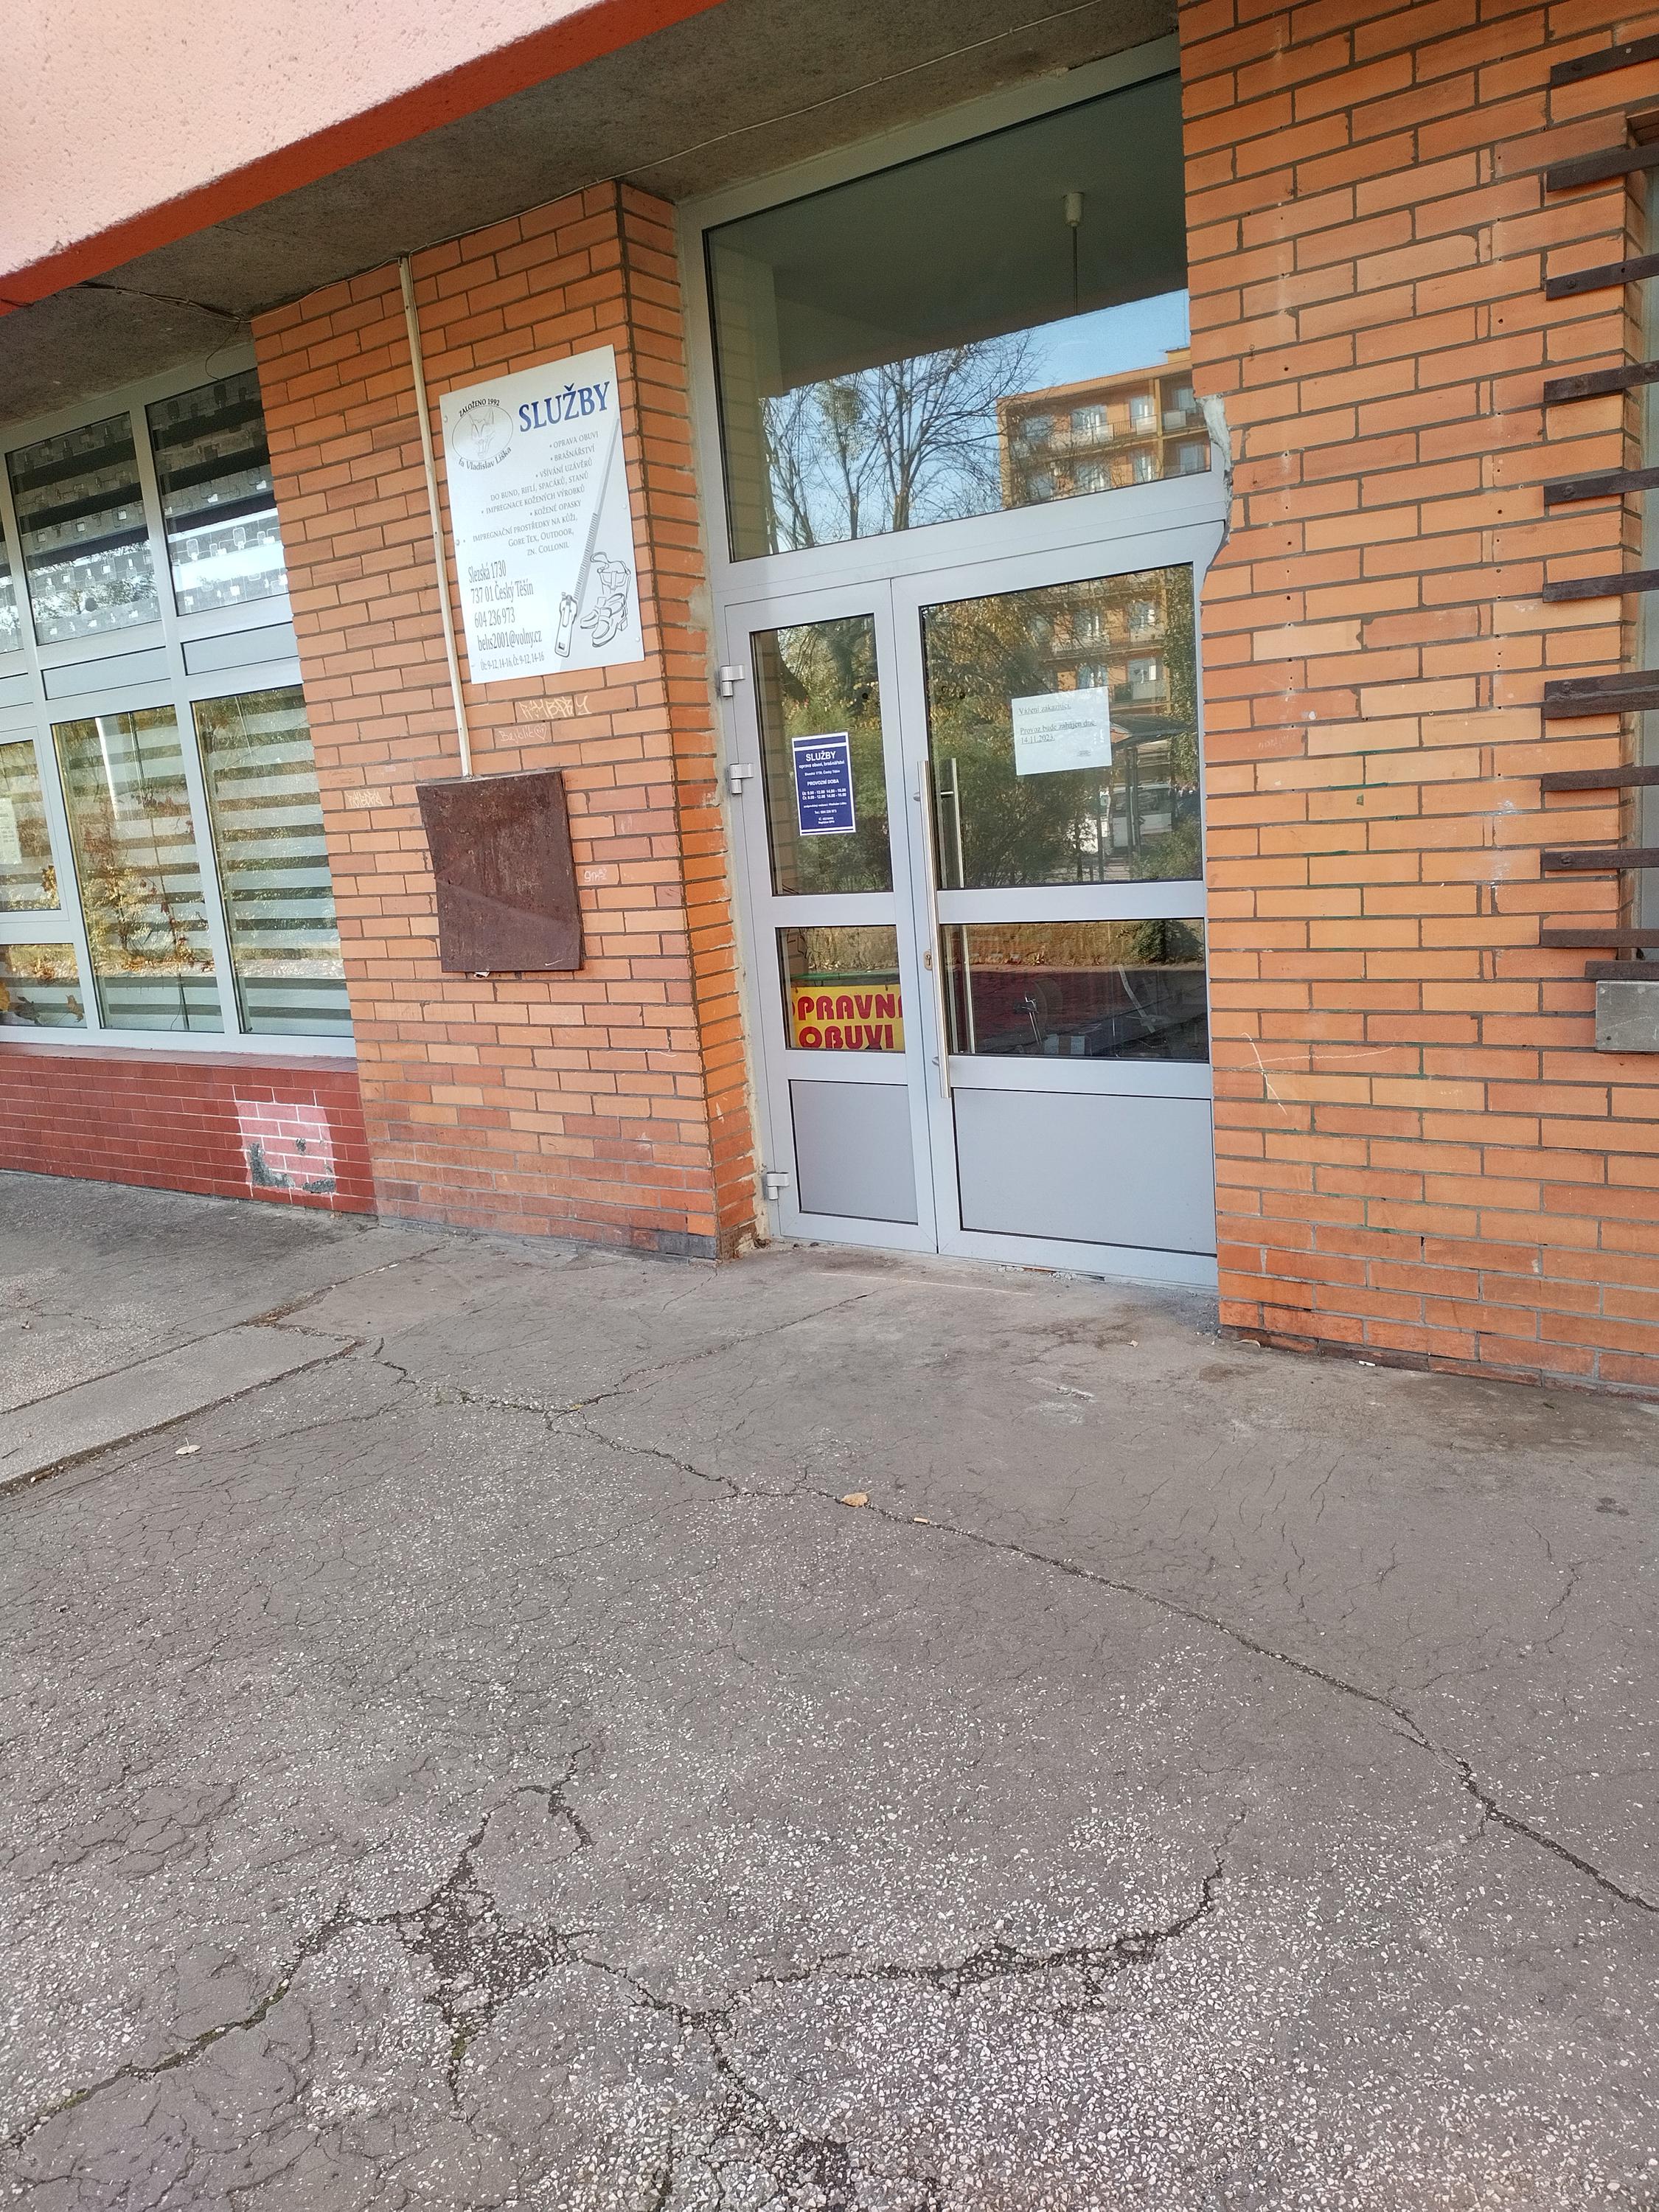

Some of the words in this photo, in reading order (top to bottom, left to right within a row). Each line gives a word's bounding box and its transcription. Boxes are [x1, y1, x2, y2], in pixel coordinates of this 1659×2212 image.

[459, 398, 487, 417] ZALOŽENO
[487, 398, 500, 406] 1992
[518, 381, 610, 432] SLUŽBY
[553, 437, 577, 448] OPRAVA
[578, 431, 599, 442] OBUVI
[554, 443, 595, 462] BRAŠNÁŘSTVÍ
[466, 460, 495, 470] Vladislav
[539, 465, 563, 478] VŠÍVÁNÍ
[565, 457, 593, 472] UZÁVĚRŮ
[490, 493, 500, 501] DO
[501, 489, 520, 499] BUND,
[521, 484, 538, 495] RIFLÍ,
[568, 470, 588, 484] STANŮ
[486, 500, 524, 515] IMPREGNACE
[524, 493, 556, 506] KOŽENÝCH
[557, 483, 585, 498] VÝROBKŮ
[534, 504, 558, 517] KOŽENÉ
[558, 498, 581, 510] OPASKY
[473, 525, 512, 543] IMPREGNAČNÍ
[513, 518, 550, 534] PROSTŘEDKY
[551, 517, 561, 526] NA
[467, 562, 491, 583] Slezská
[490, 560, 507, 579] 1730
[470, 587, 483, 604] 737
[484, 585, 494, 602] 01
[494, 580, 515, 603] Český
[515, 578, 534, 597] Těšín
[474, 611, 487, 628] 604
[487, 608, 501, 626] 236
[501, 606, 515, 624] 973
[531, 651, 545, 663] 14-16
[805, 750, 836, 762] SLUŽBY
[792, 993, 903, 1020] PRAVN
[799, 1024, 894, 1050] OBUVI
